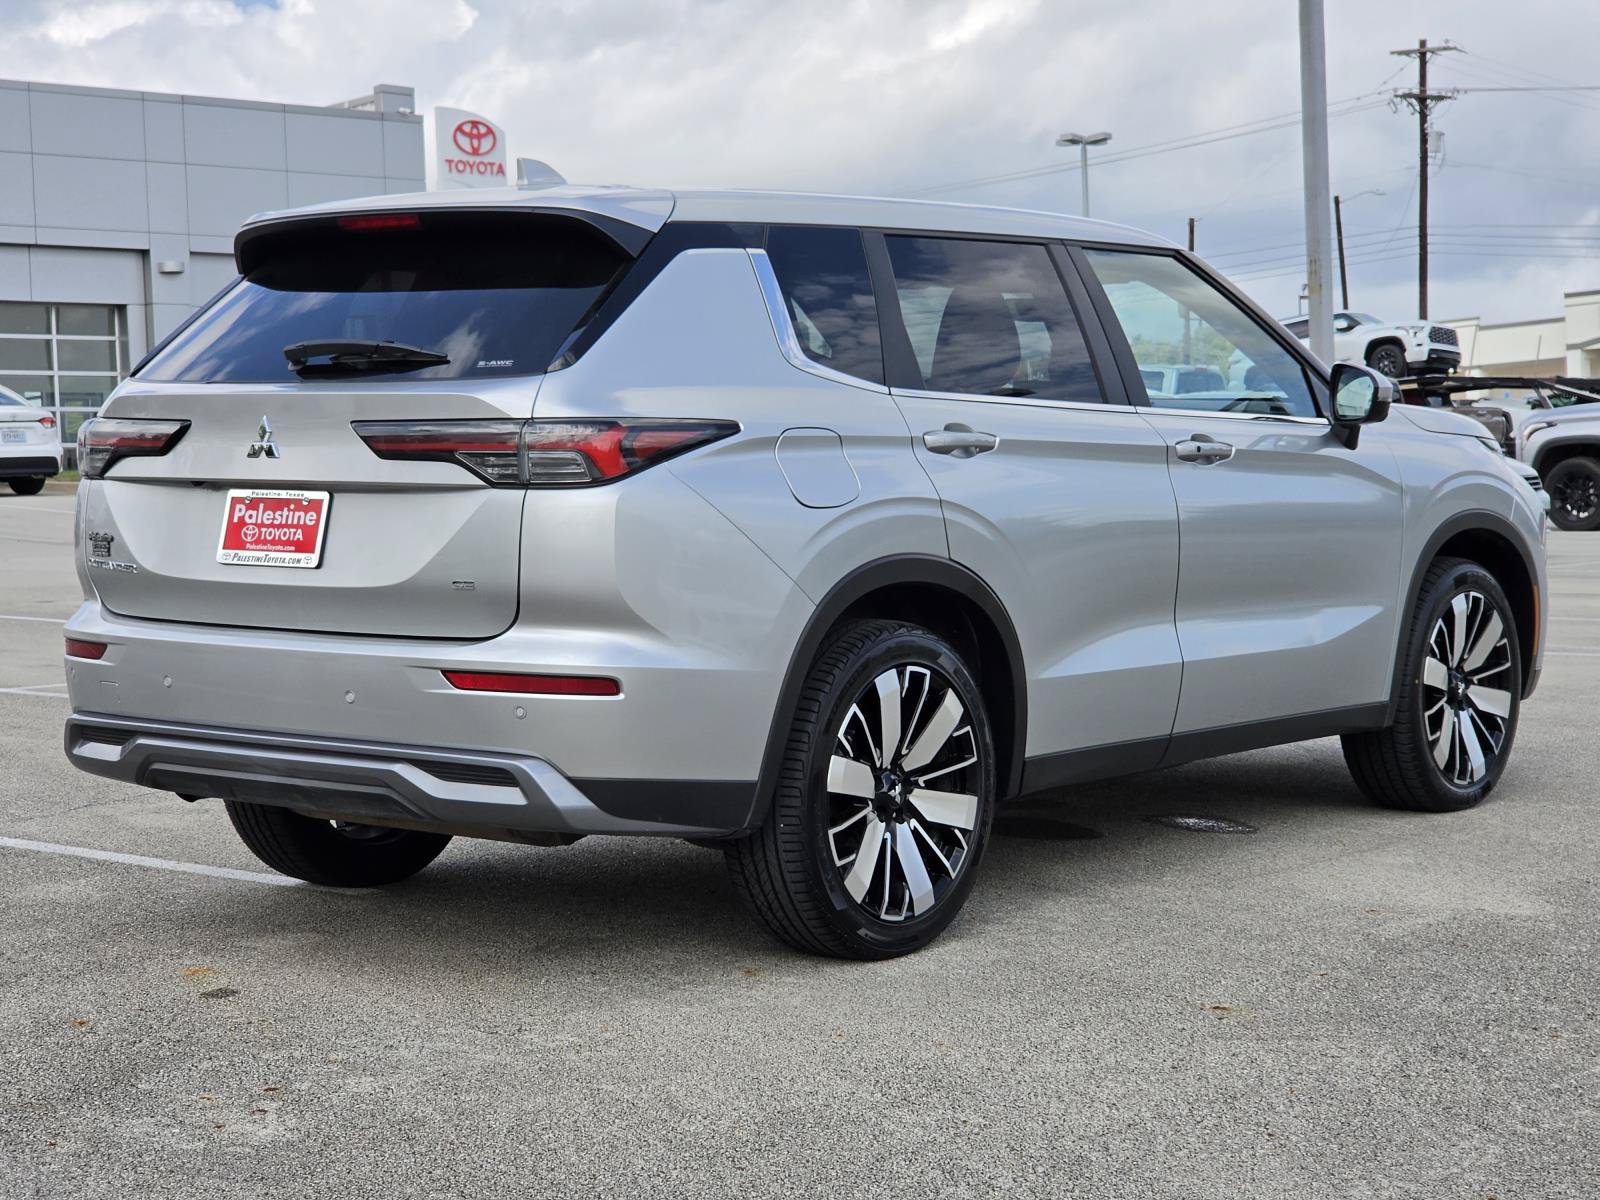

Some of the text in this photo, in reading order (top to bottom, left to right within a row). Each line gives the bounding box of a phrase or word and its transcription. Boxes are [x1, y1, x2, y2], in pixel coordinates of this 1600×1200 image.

[445, 159, 506, 177] TOYOTA
[233, 503, 317, 525] Palestine
[261, 528, 303, 541] TOYOTA
[246, 543, 295, 552] PalestineToyota.com
